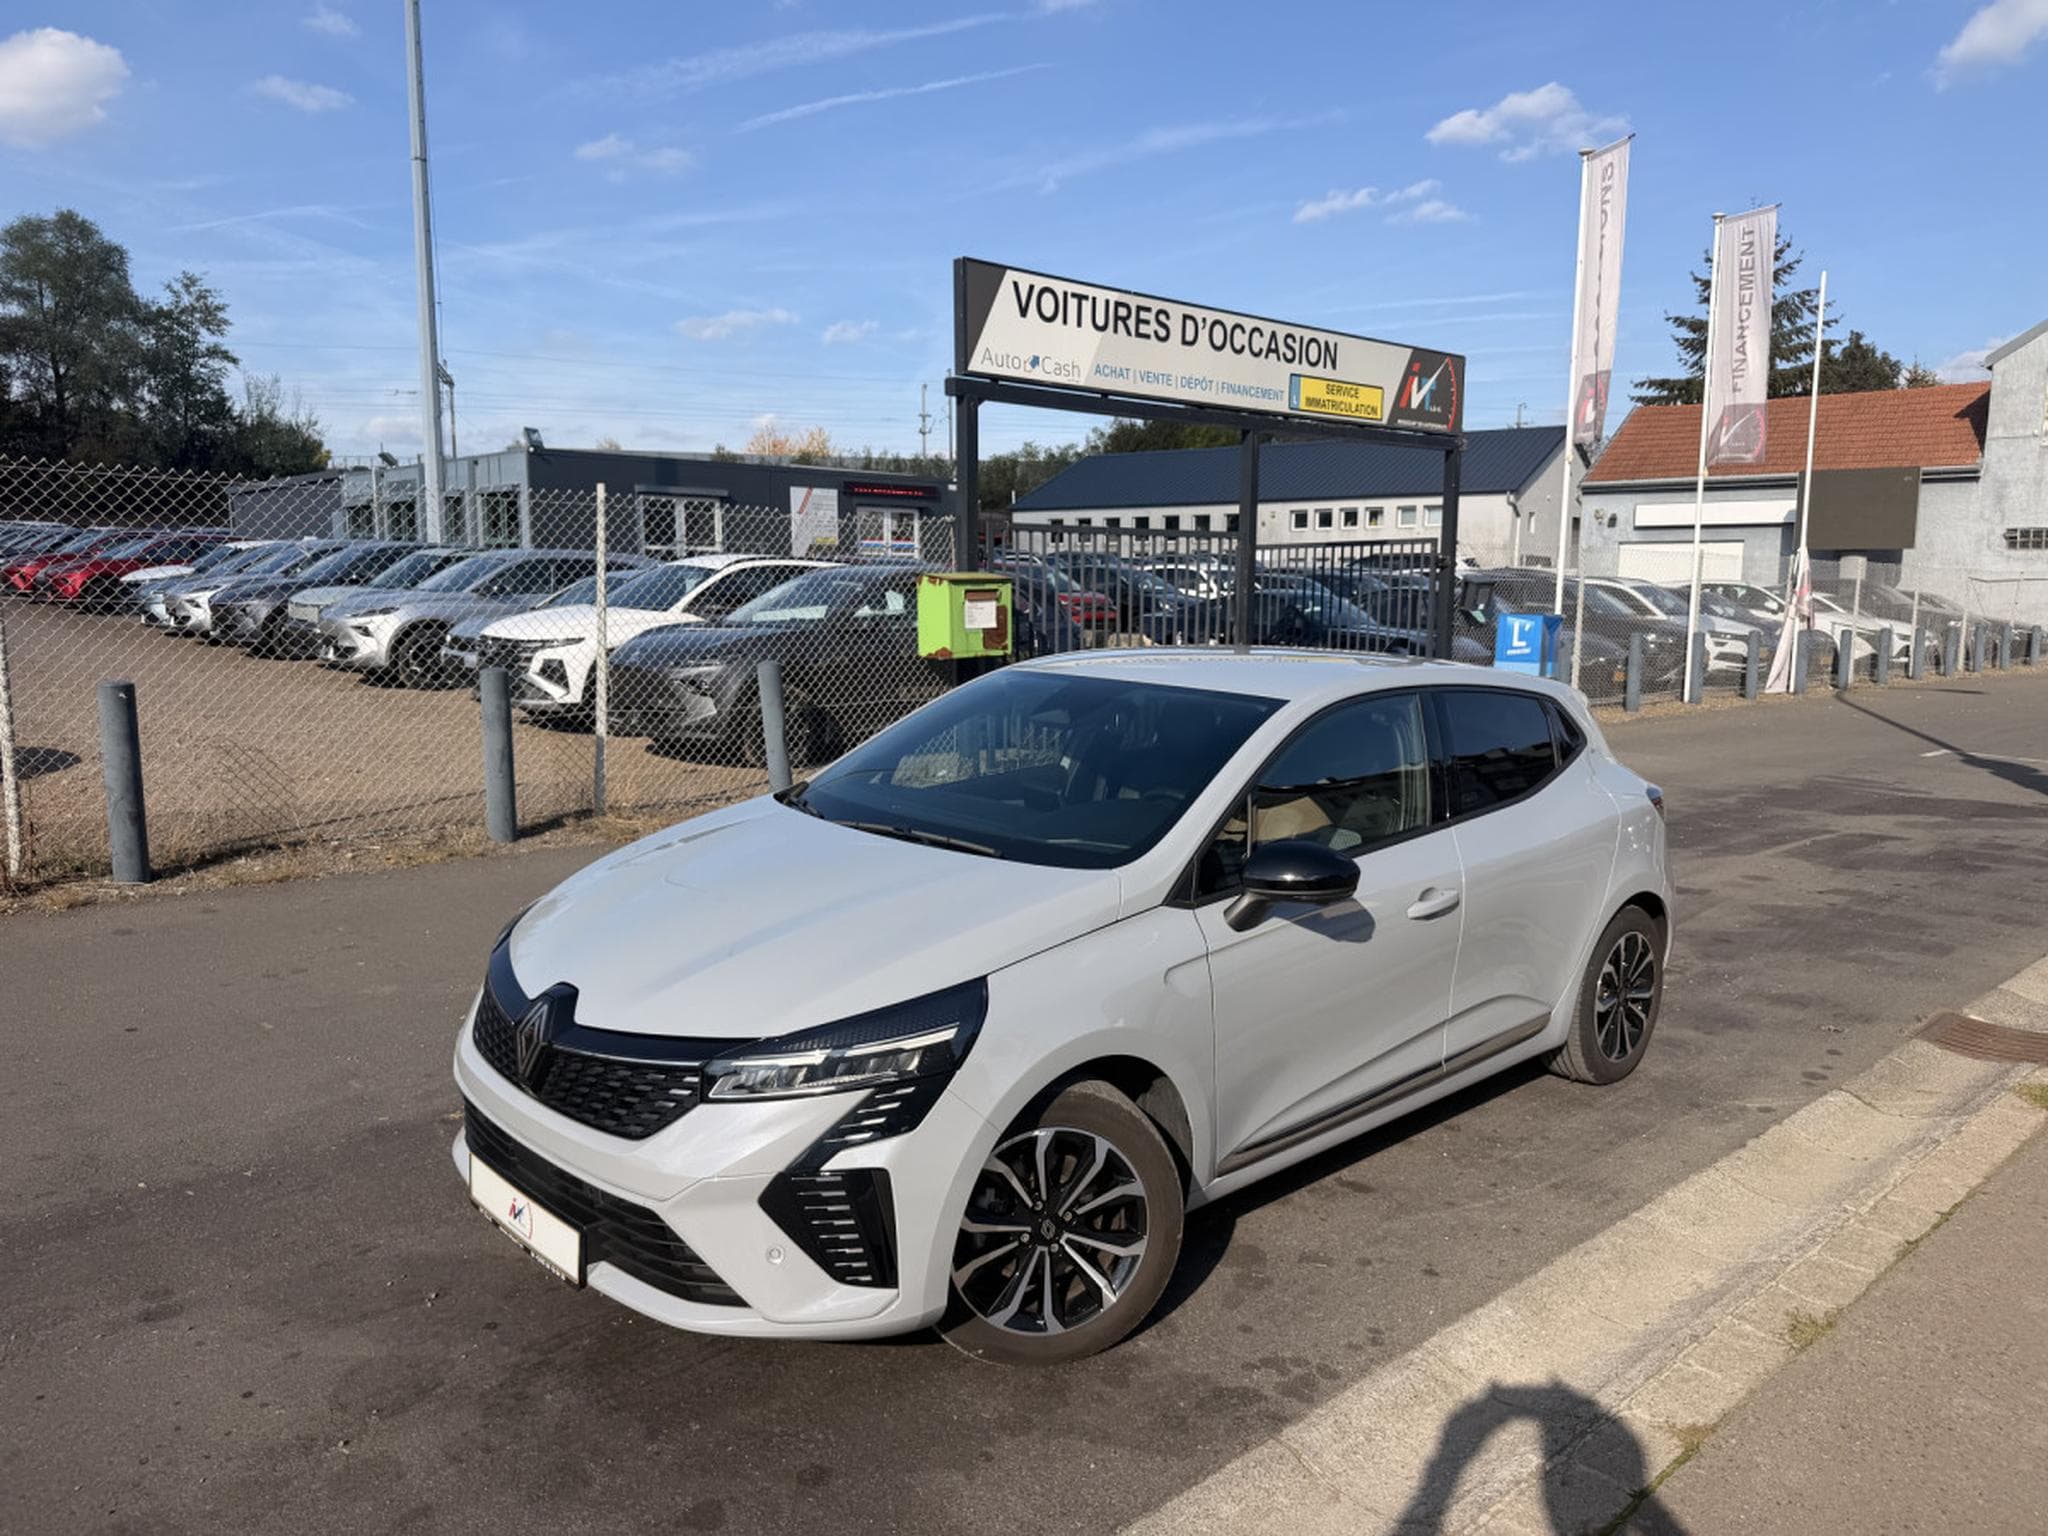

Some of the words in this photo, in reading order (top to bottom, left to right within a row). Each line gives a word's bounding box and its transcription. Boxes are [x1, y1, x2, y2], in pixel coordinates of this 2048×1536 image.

[1012, 280, 1171, 343] VOITURES
[1181, 313, 1338, 371] D'OCCASION
[1731, 226, 1755, 394] FINANCEMENT
[981, 346, 1022, 370] Auto
[1041, 356, 1081, 379] Cash
[1094, 363, 1130, 379] ACHAT
[1139, 371, 1173, 387] VENTE
[1221, 381, 1285, 402] FINANCEMENT
[1326, 384, 1360, 399] SERVICE
[1305, 396, 1378, 416] IMMATRICULATION
